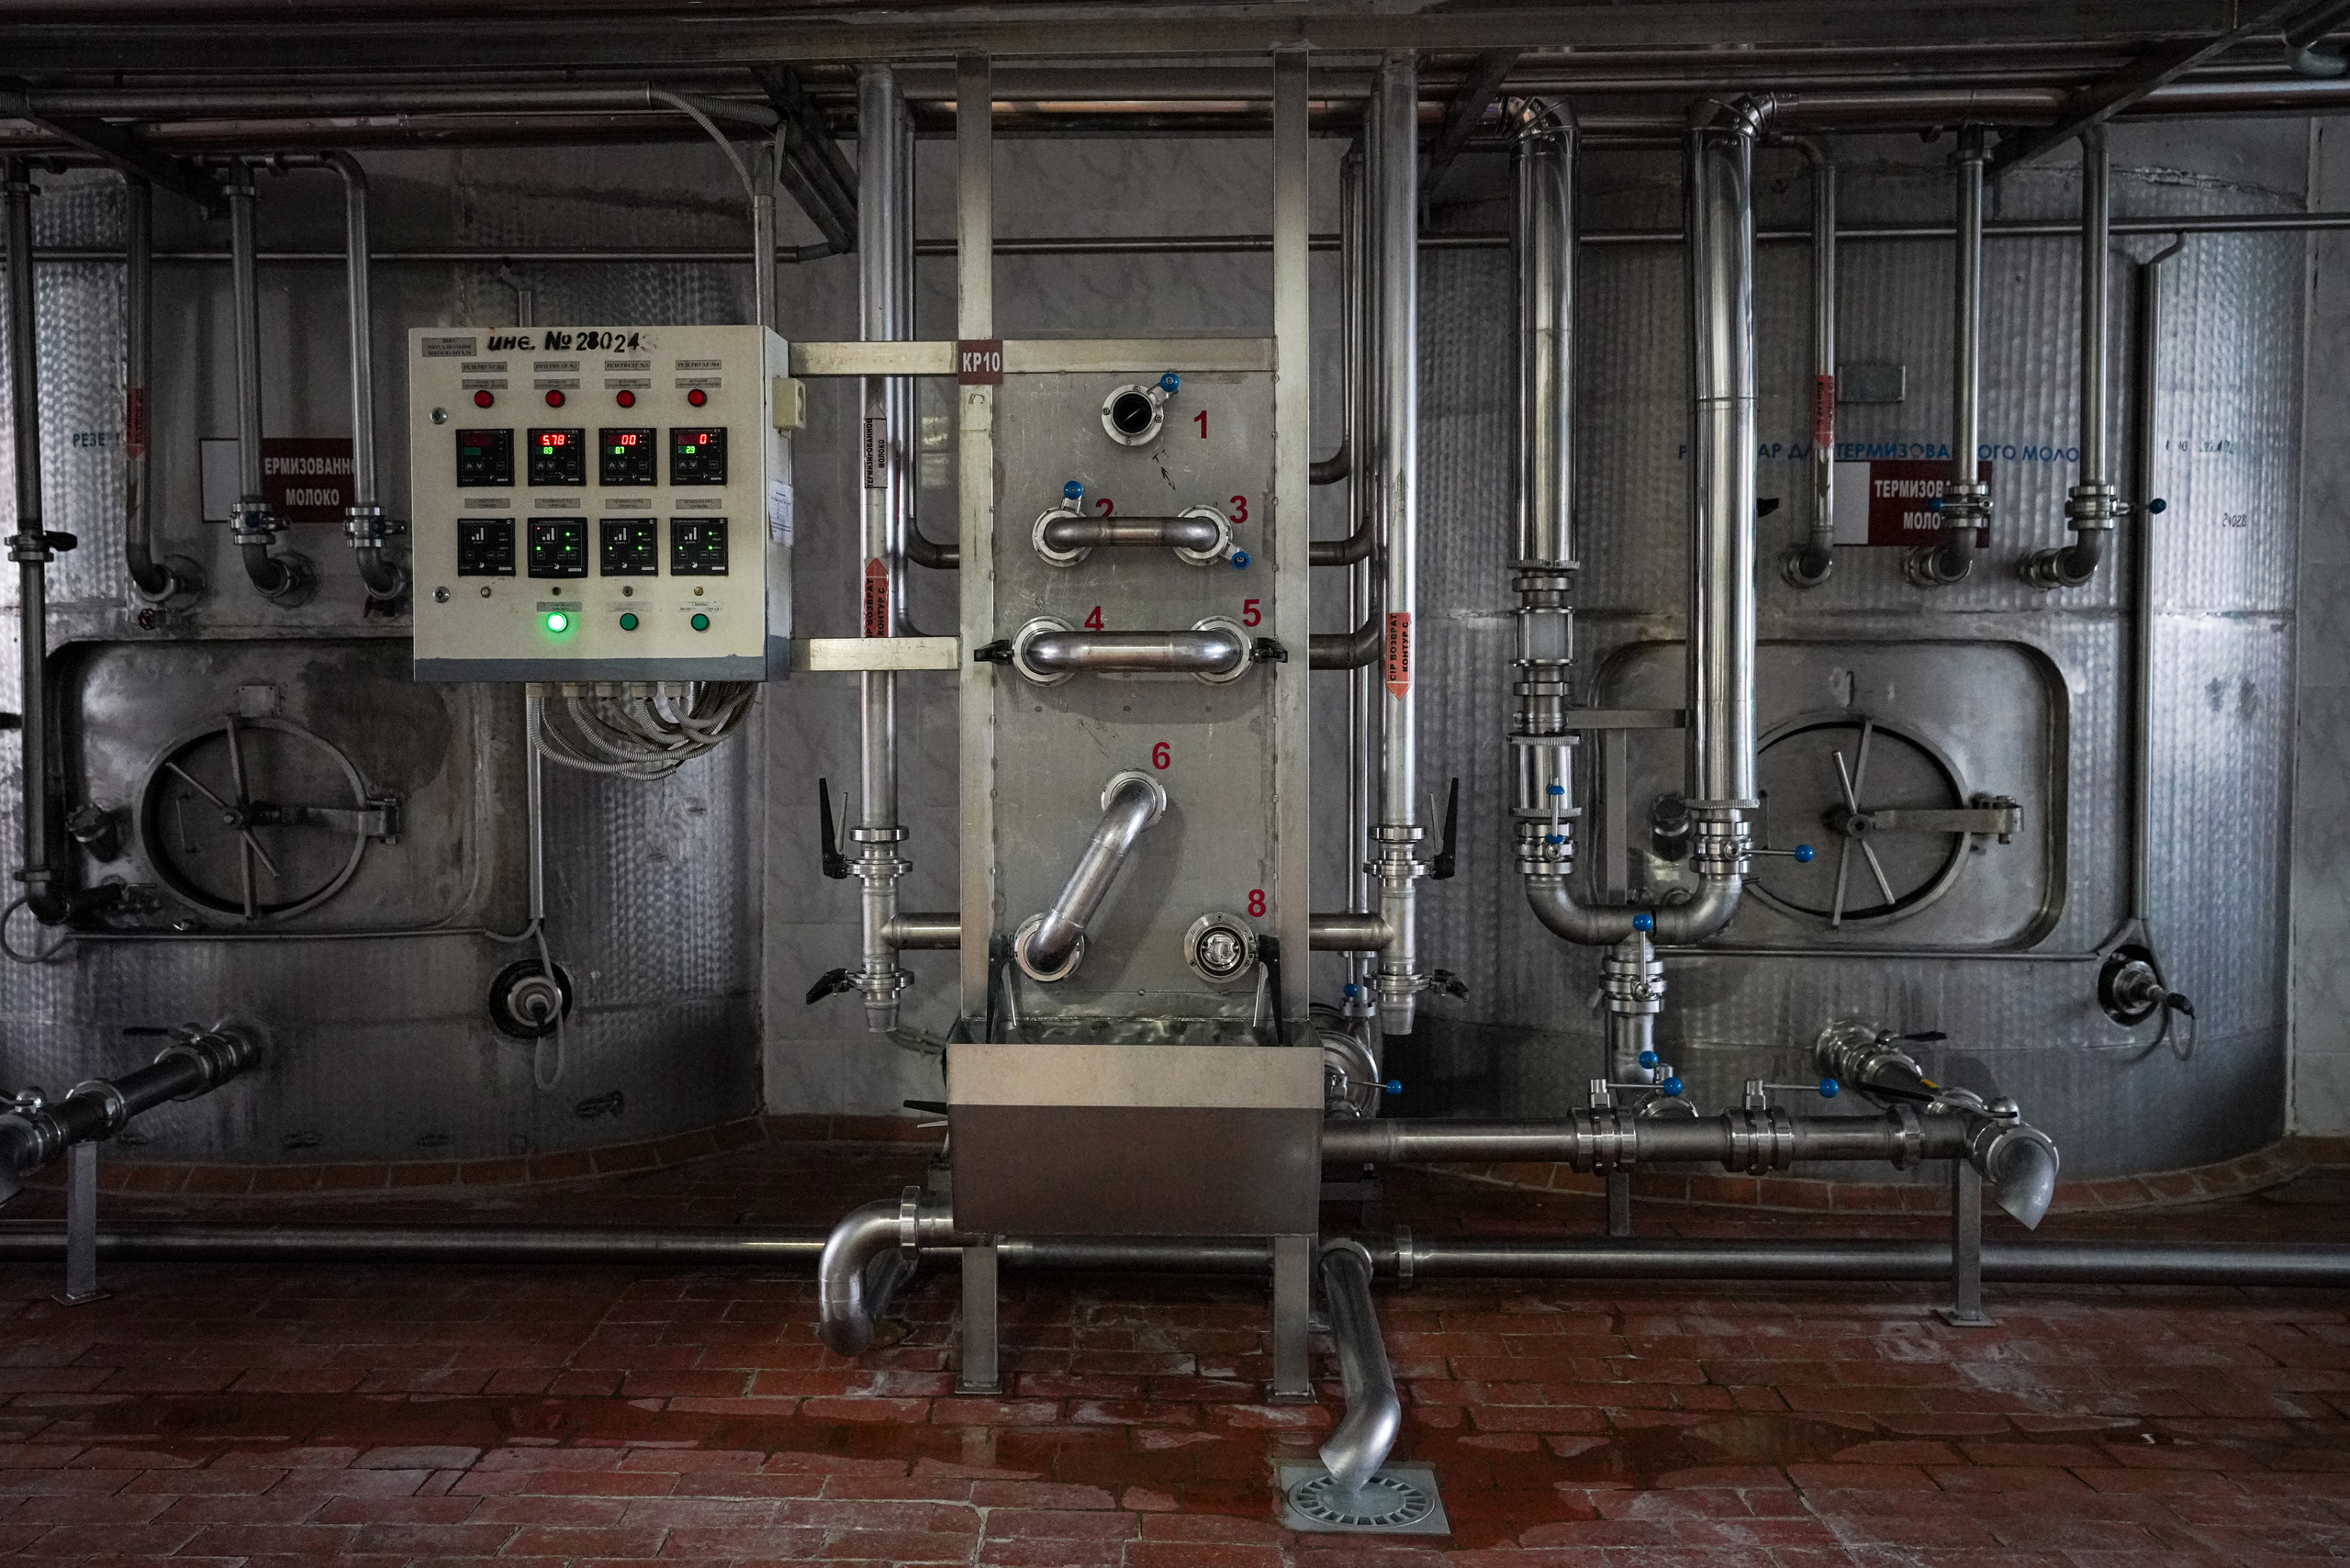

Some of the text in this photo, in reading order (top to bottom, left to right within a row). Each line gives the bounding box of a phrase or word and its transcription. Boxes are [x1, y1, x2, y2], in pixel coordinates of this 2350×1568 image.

[1193, 409, 1208, 439] 1
[1836, 442, 2017, 461] ТЕРМИЗОВАОГО
[2022, 445, 2080, 463] МОЛО
[264, 457, 354, 476] ЕРМИЗОВАНН
[285, 488, 340, 506] МОЛОКО
[1874, 479, 1952, 498] ТЕРМИЗОВ
[1095, 498, 1114, 518] 2
[1229, 496, 1248, 523] 3
[1903, 511, 1945, 530] МОЛО
[1084, 606, 1104, 631] 4
[1242, 599, 1262, 627] 5
[1151, 741, 1171, 770] 6
[1248, 889, 1267, 917] 8
